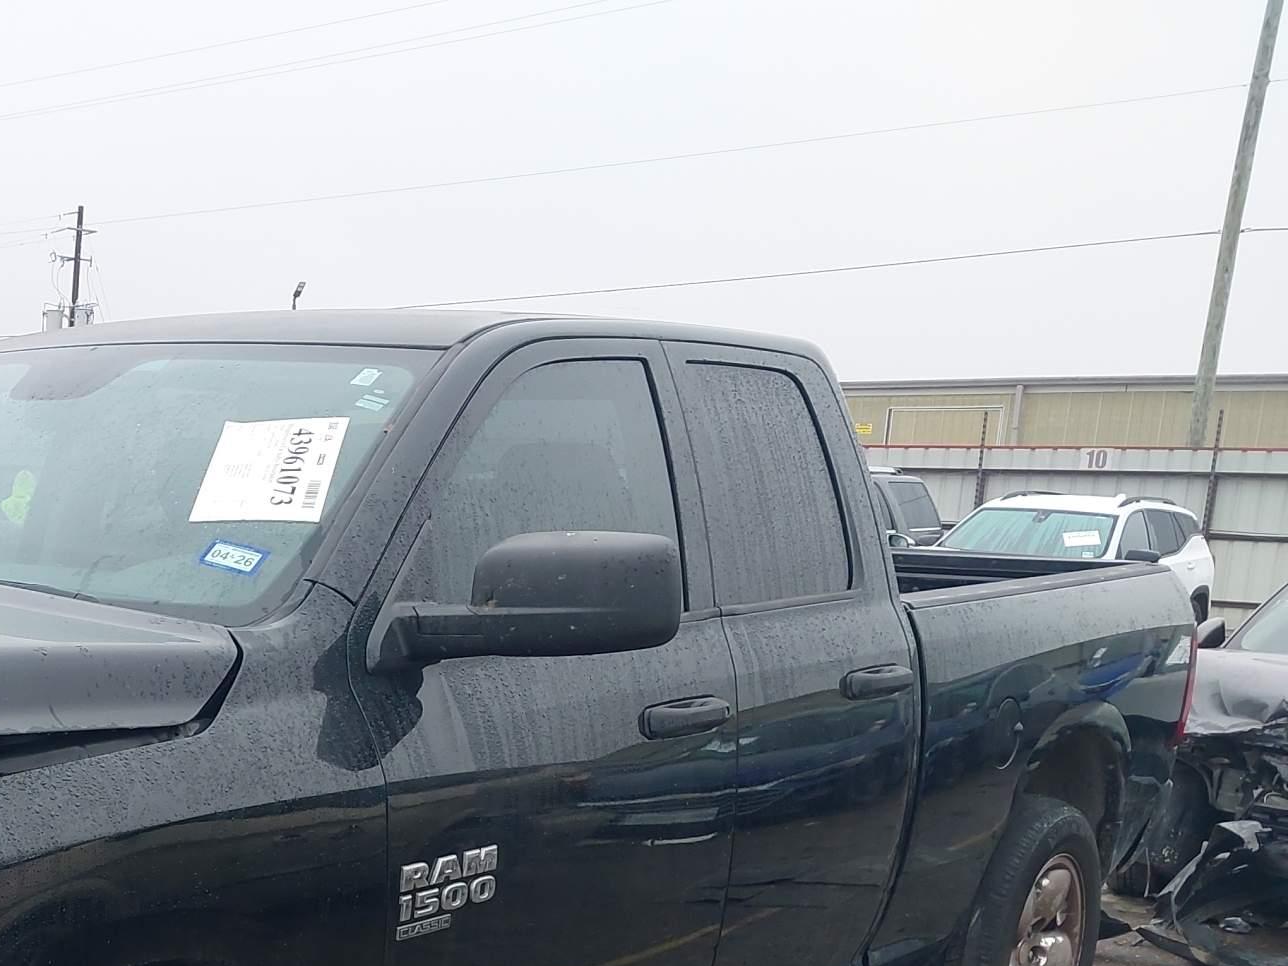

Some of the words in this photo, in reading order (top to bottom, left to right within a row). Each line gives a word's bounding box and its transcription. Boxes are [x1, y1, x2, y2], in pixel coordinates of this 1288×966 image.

[269, 427, 315, 507] 43961073
[1086, 449, 1108, 469] 10
[399, 844, 498, 892] RAM
[398, 874, 497, 922] 1500
[398, 917, 451, 938] CLASSIC
